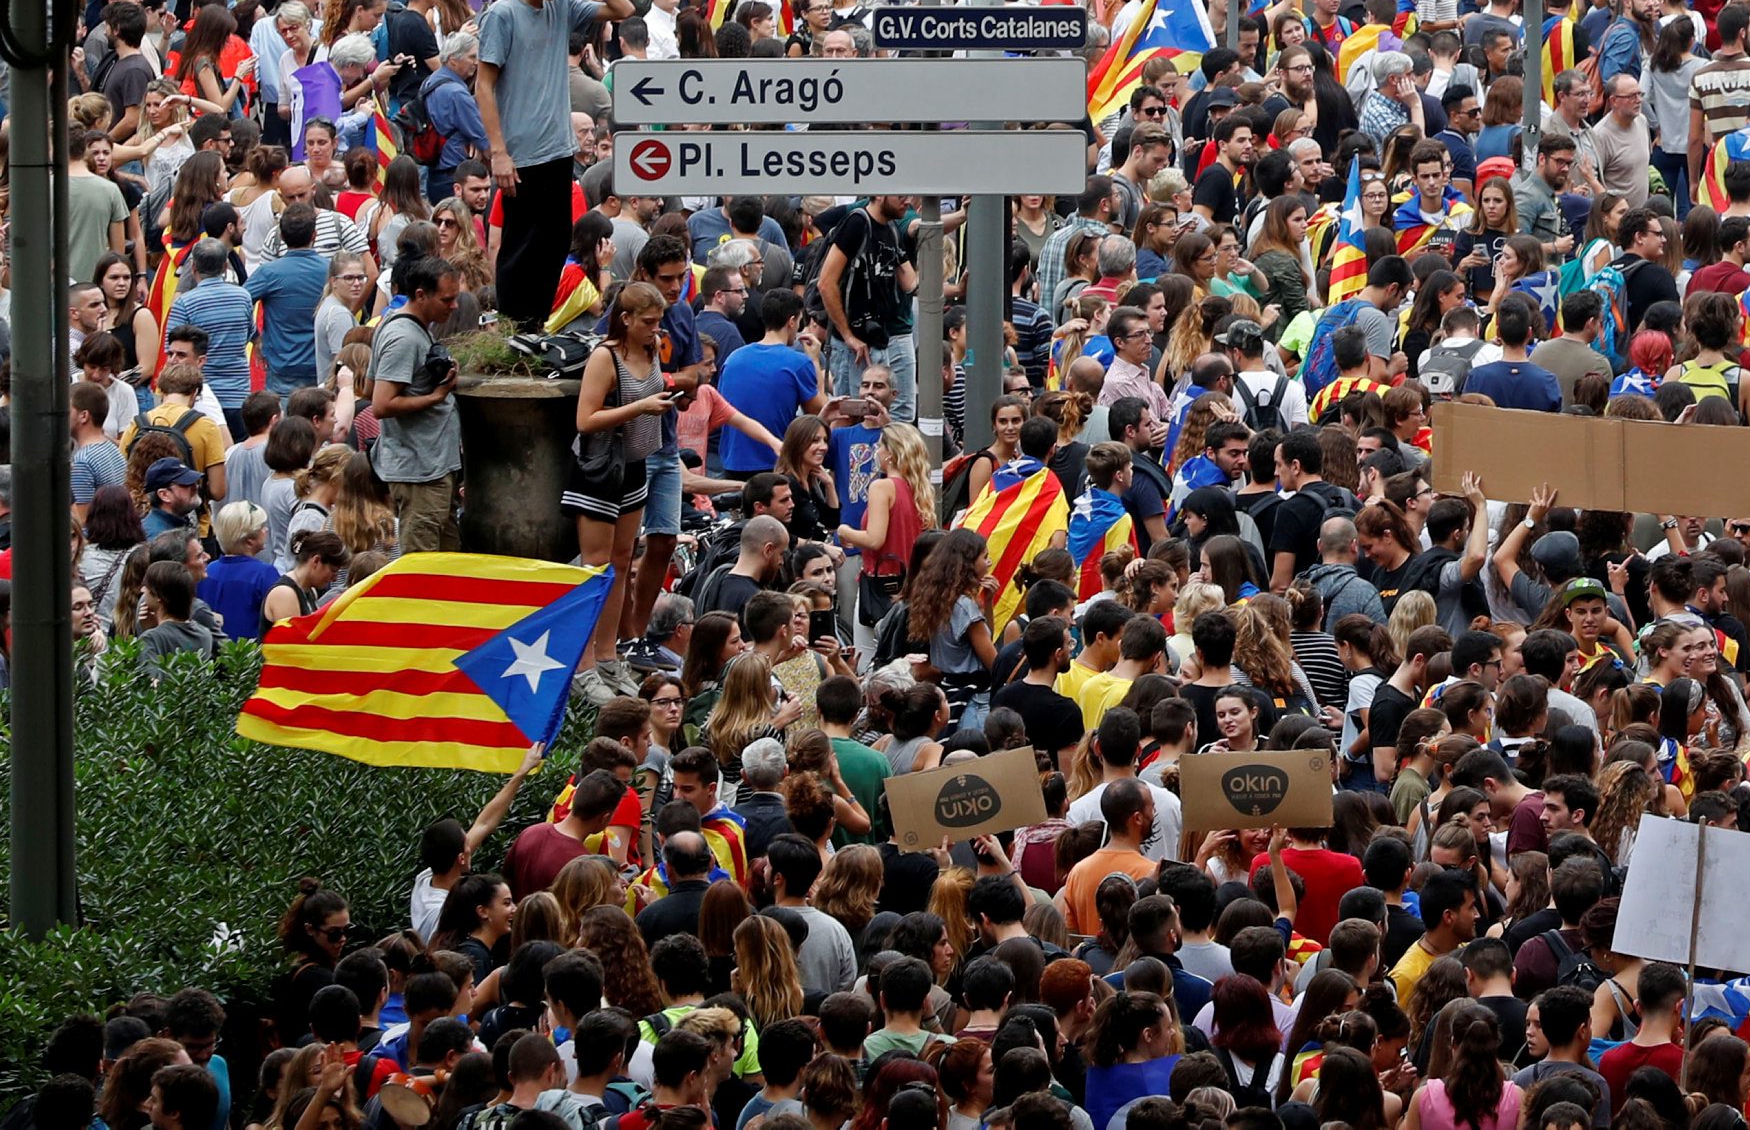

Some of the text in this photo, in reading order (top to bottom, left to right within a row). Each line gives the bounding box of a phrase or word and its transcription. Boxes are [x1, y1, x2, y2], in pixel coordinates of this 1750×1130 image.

[879, 16, 1081, 39] G.V. Corts Catalanes
[679, 69, 844, 112] C. Aragó
[680, 143, 896, 183] Pl. Lesseps
